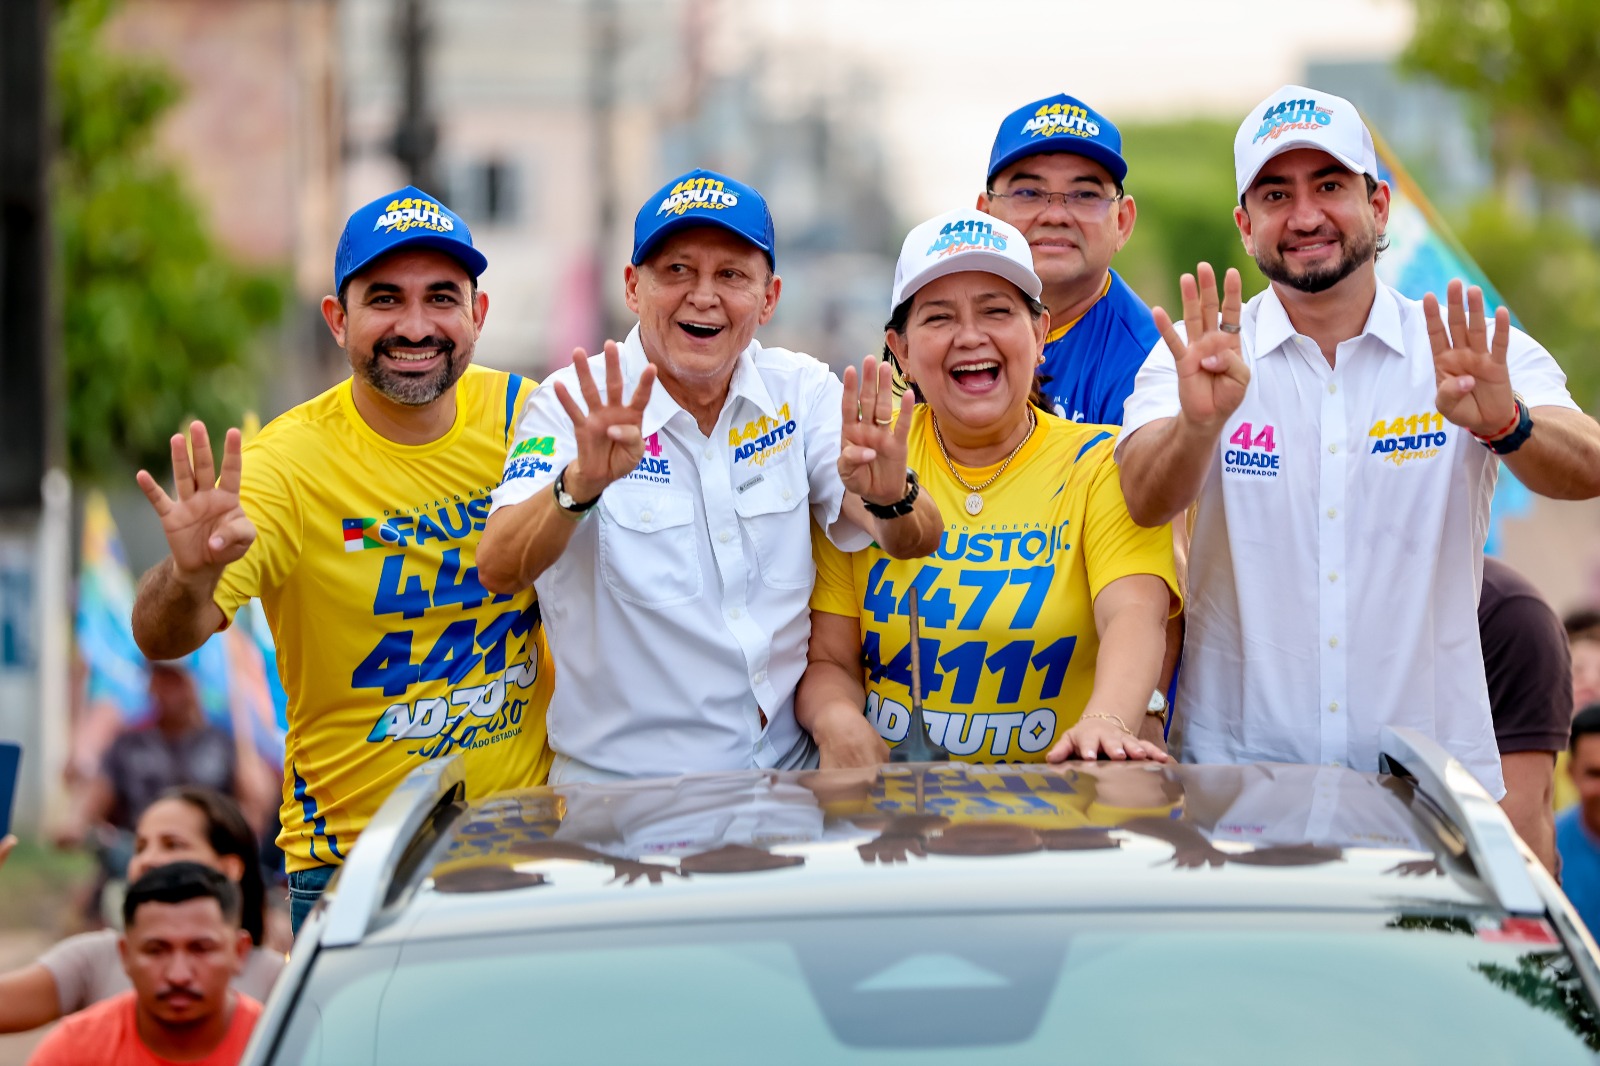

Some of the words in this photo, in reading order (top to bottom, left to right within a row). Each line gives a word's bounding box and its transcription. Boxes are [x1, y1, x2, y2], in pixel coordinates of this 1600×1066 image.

[1034, 103, 1087, 119] 44111
[1263, 99, 1316, 121] 44111
[1020, 114, 1100, 136] ADJUTO
[1031, 123, 1092, 138] Afonso
[1252, 109, 1332, 145] ADJUTO
[1262, 122, 1323, 145] Afonso
[670, 178, 724, 195] 44111
[386, 198, 439, 214] 44111
[656, 188, 738, 216] ADJUTO
[665, 199, 729, 218] Afonso
[373, 208, 454, 232] ADJUTO
[385, 218, 449, 234] Afonso
[940, 220, 992, 236] 44111
[926, 231, 1007, 256] ADJUTO
[1369, 411, 1444, 439] 44111
[734, 420, 796, 464] ADJUTO
[1229, 422, 1276, 453] 44
[1371, 431, 1447, 454] ADJUTO
[634, 457, 671, 475] ADE
[1224, 450, 1280, 469] CIDADE
[1383, 448, 1440, 466] Afonso
[1225, 466, 1277, 477] GOVERNADOR
[928, 530, 1048, 563] USTO
[373, 547, 514, 620] 44
[863, 558, 1055, 630] 4477
